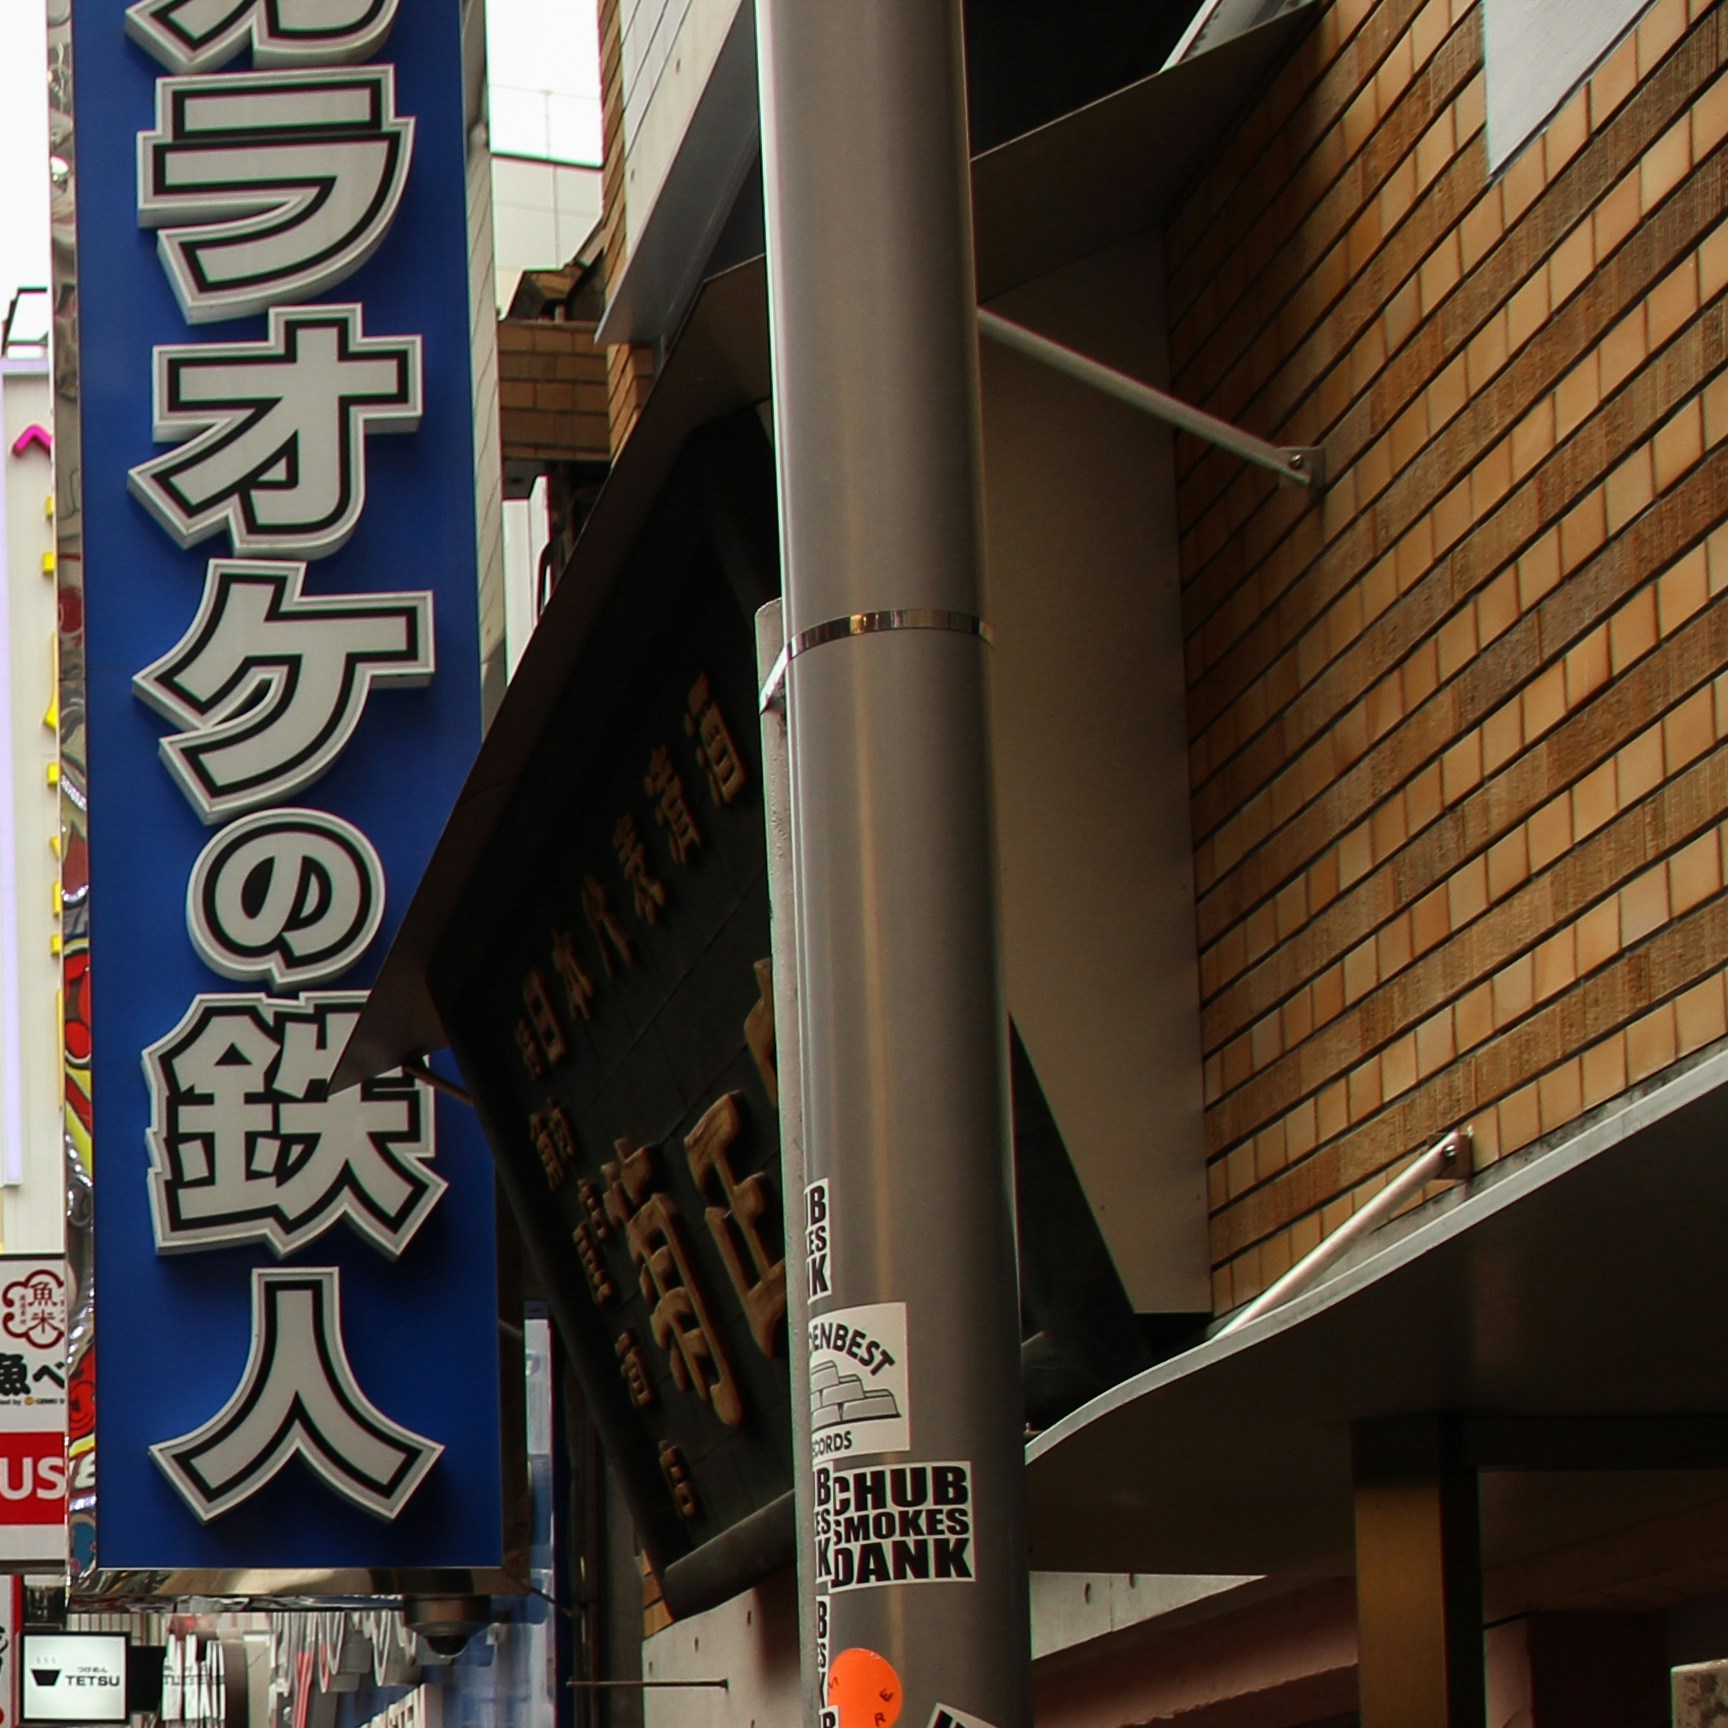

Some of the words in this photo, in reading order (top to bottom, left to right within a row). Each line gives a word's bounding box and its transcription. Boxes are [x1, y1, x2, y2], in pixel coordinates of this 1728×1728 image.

[124, 0, 448, 1525] ラオケの鉄人
[809, 1321, 896, 1376] ENBEST
[834, 1465, 970, 1517] CHUB
[833, 1506, 971, 1546] SMOKES
[831, 1538, 972, 1589] DANK
[65, 1674, 121, 1687] TETSU
